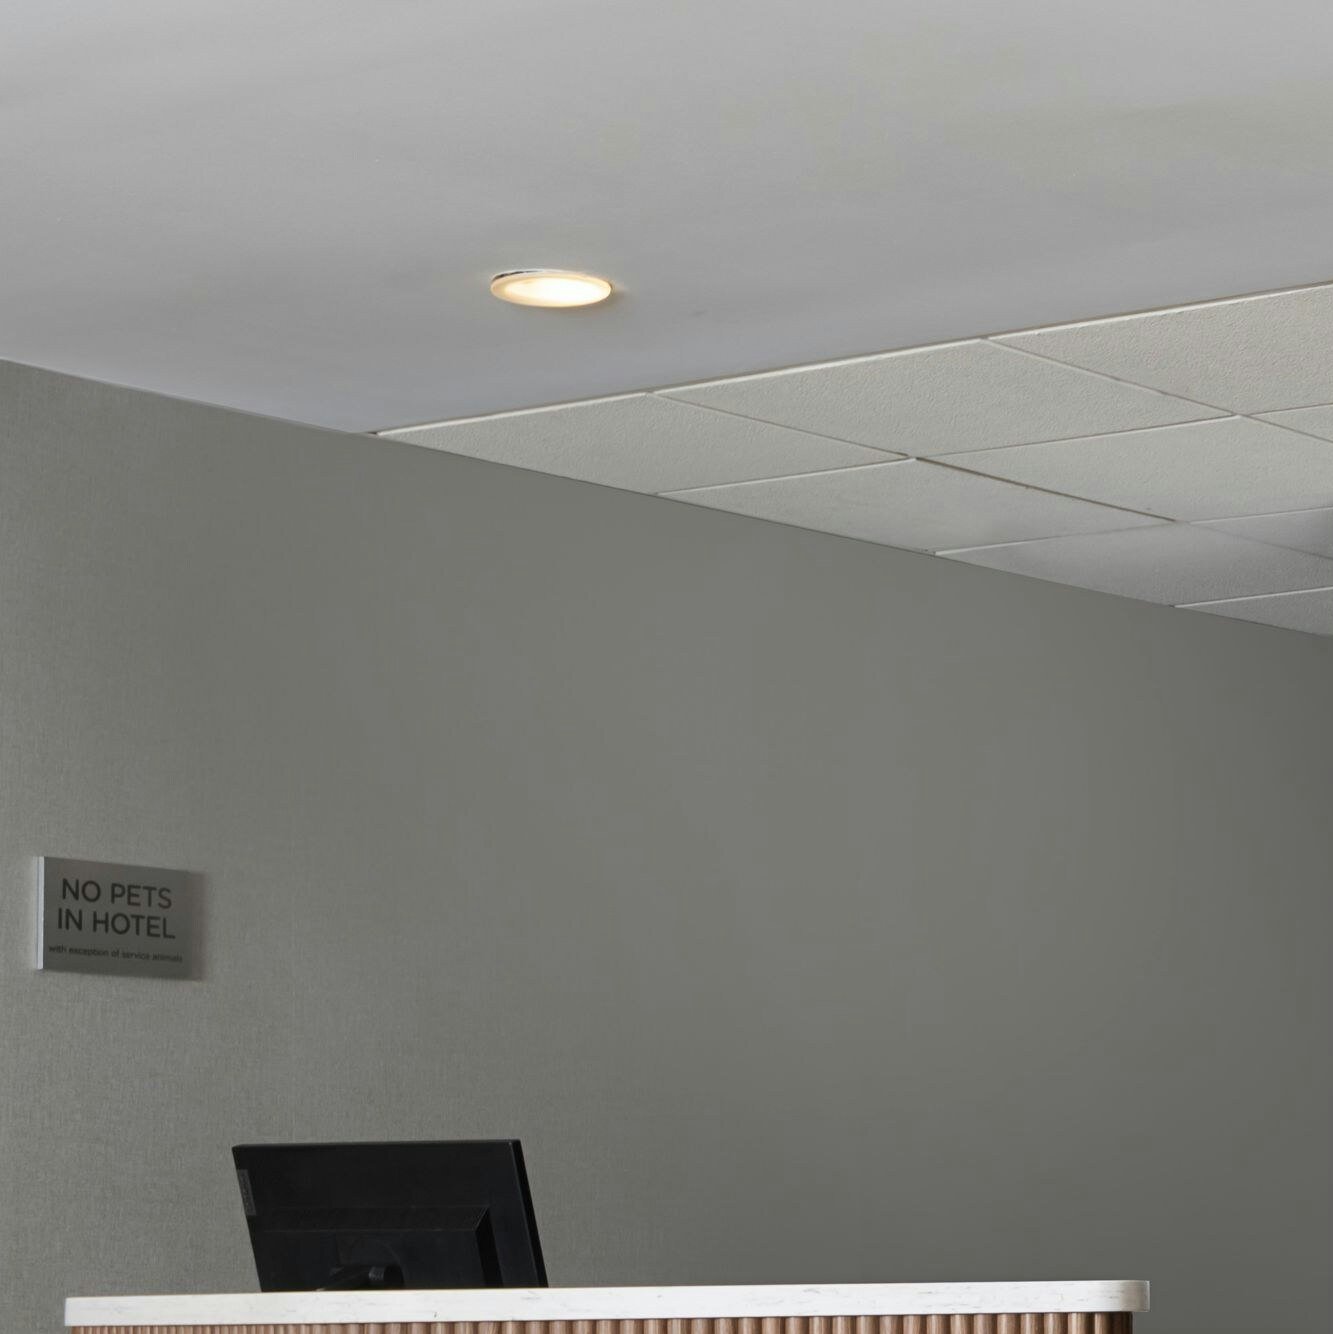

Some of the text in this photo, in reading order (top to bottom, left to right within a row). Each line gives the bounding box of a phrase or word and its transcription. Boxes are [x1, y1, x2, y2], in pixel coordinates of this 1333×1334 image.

[62, 878, 173, 909] NO PETS
[57, 907, 176, 940] IN HOTEL
[48, 944, 67, 954] with
[69, 946, 109, 958] exception
[122, 950, 150, 960] service
